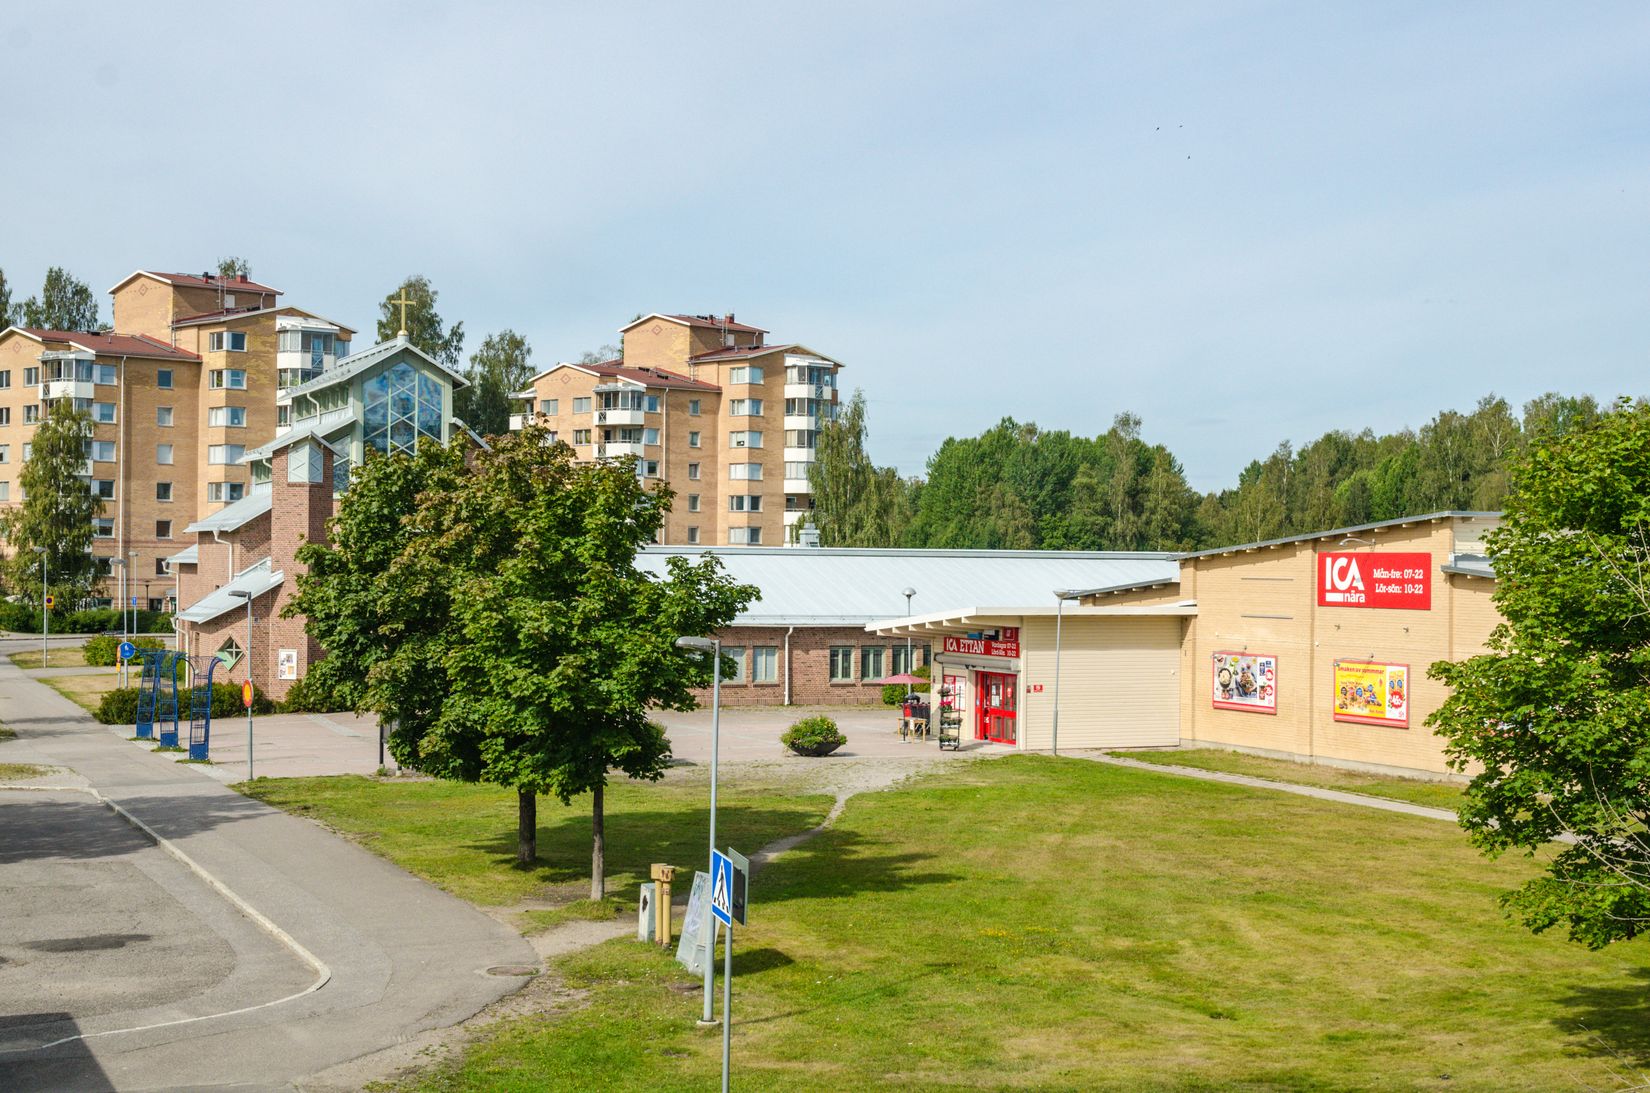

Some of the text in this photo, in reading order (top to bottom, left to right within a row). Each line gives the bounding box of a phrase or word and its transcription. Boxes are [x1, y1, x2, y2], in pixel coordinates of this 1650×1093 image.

[1325, 557, 1365, 591] ICA
[1373, 568, 1424, 579] Mån-fre: 07-22
[1375, 583, 1424, 594] Lör-sön: 10-22
[1344, 590, 1366, 603] nära
[946, 638, 984, 653] ICA ETTAN
